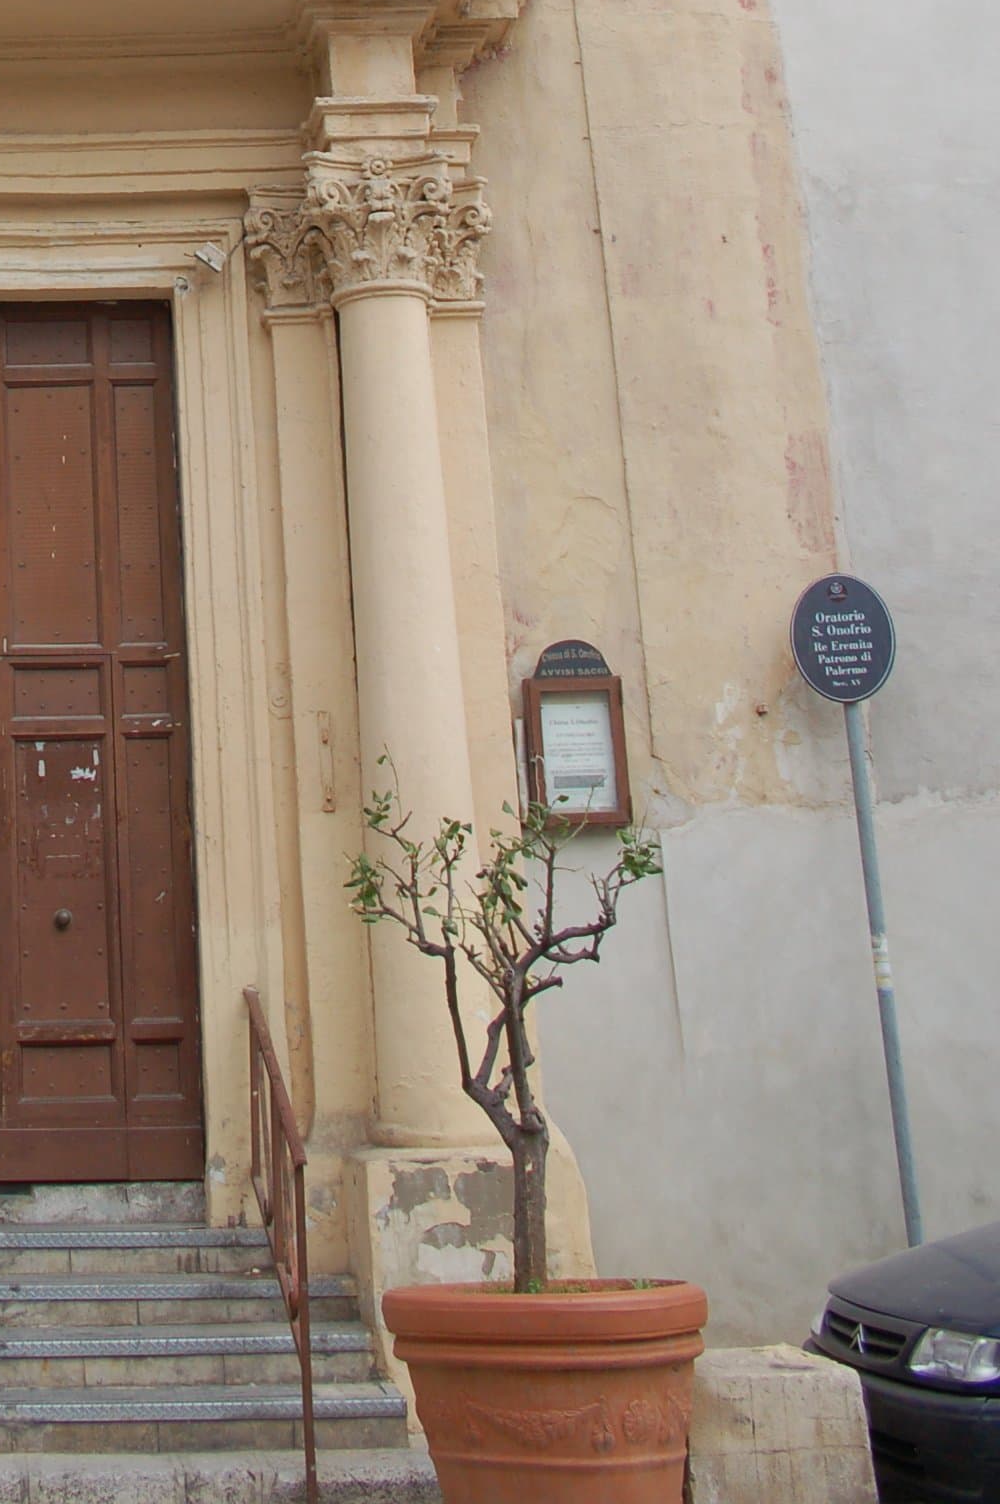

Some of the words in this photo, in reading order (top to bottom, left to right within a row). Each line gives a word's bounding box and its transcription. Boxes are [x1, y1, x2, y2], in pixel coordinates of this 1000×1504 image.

[815, 609, 865, 623] Oratorio
[811, 625, 823, 637] S.
[826, 623, 872, 636] Onofrio
[814, 641, 828, 652] Re
[831, 639, 873, 651] Eremita
[817, 654, 858, 664] Patrono
[860, 651, 872, 661] di
[825, 665, 867, 676] Palermo
